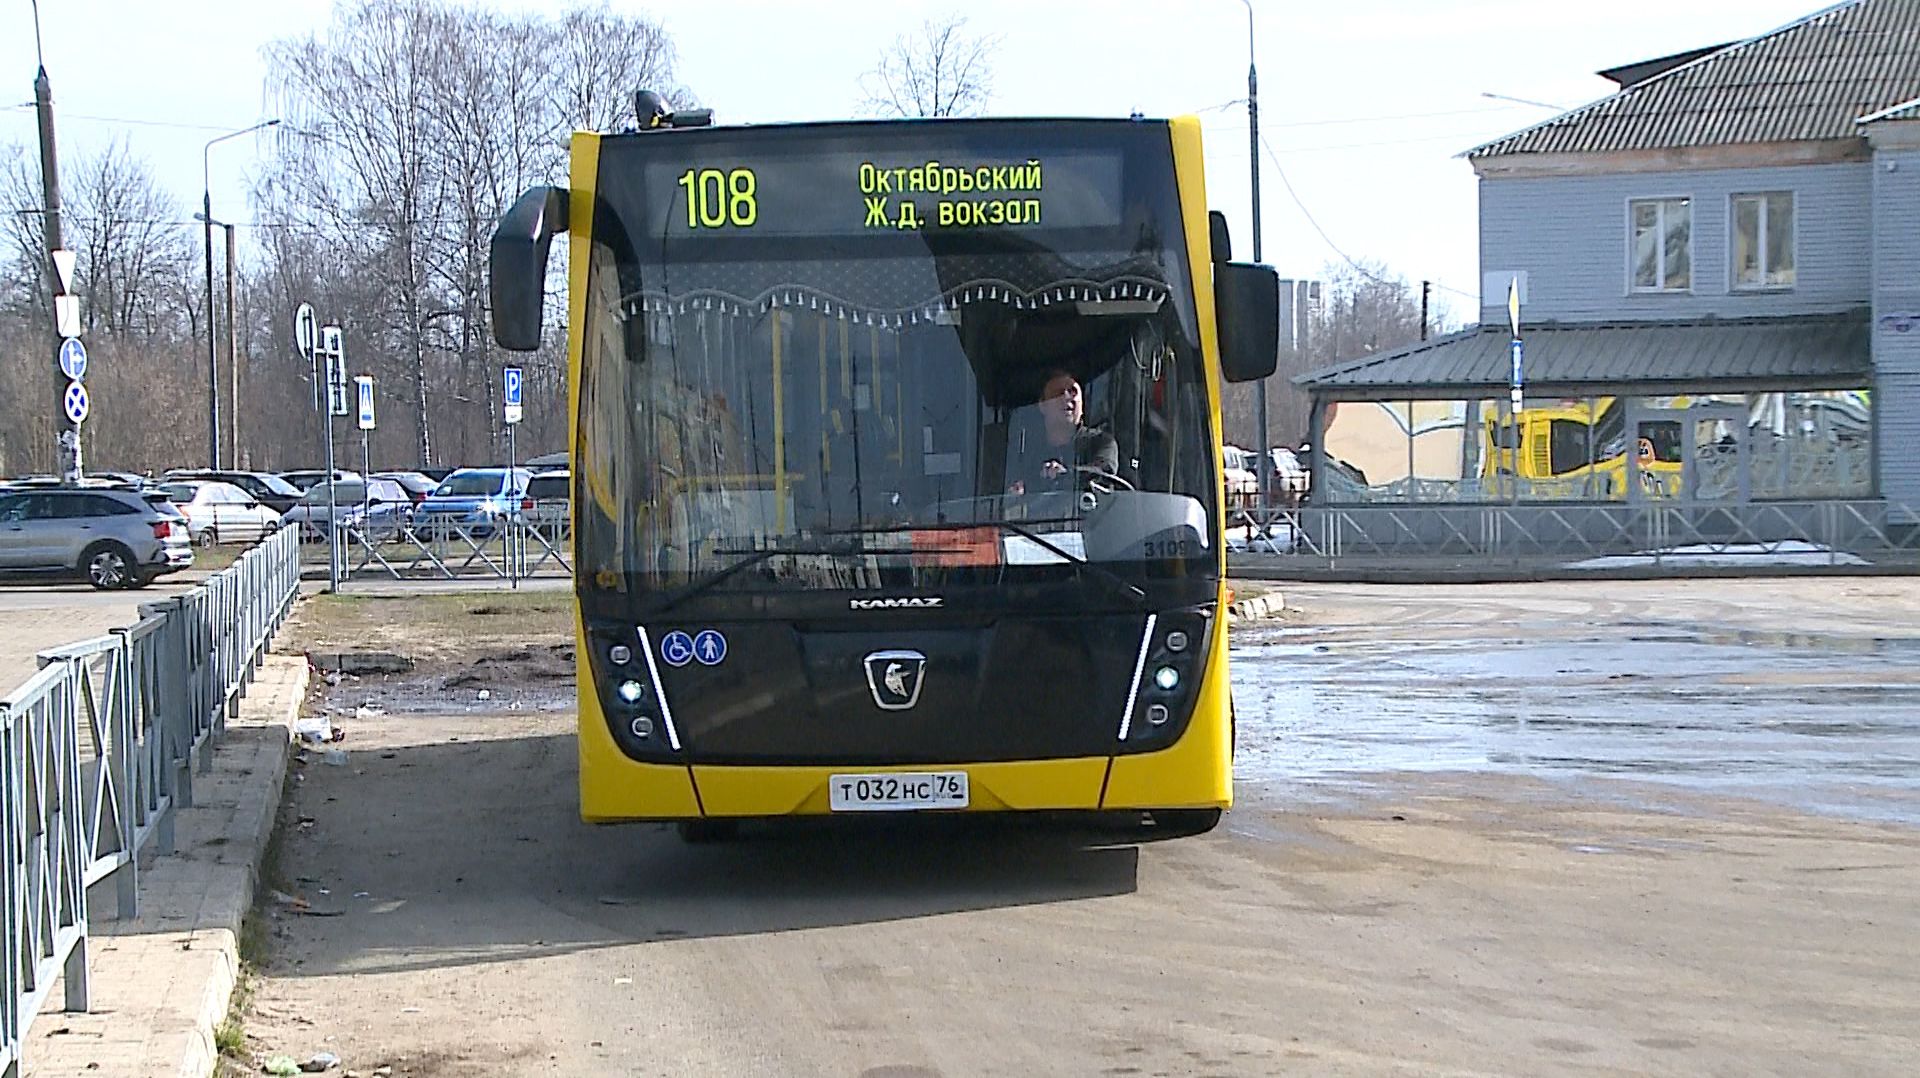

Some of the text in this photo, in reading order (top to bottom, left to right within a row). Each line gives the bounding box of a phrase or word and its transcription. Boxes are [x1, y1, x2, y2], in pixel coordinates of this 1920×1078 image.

[859, 160, 1042, 195] Октябрьский
[678, 169, 757, 228] 108
[864, 197, 1041, 229] Ж.д. вокзал
[849, 597, 944, 610] KAMAZ
[936, 776, 959, 793] 76
